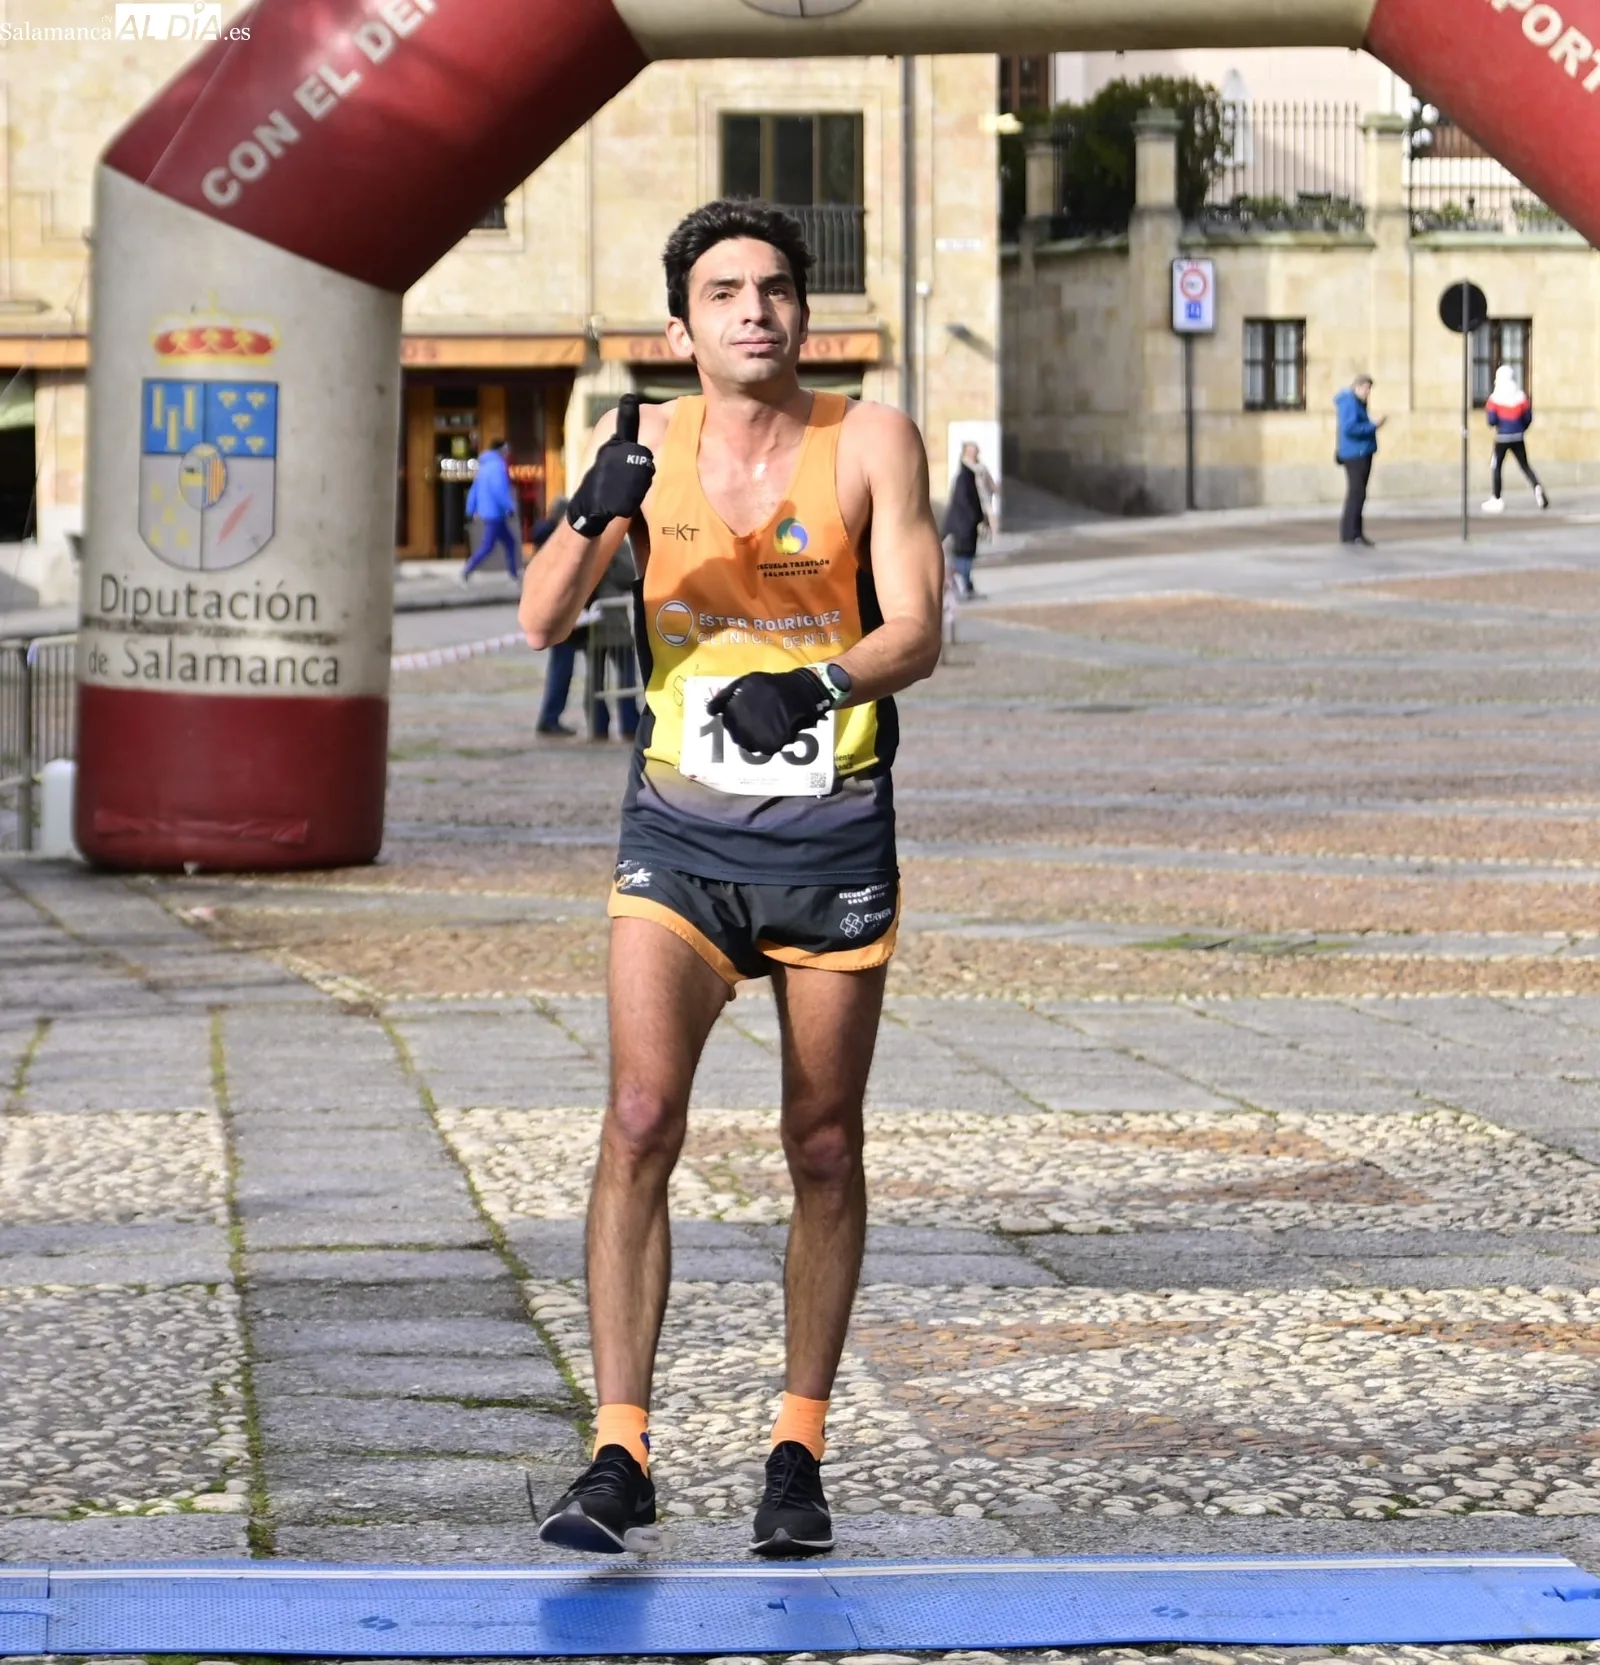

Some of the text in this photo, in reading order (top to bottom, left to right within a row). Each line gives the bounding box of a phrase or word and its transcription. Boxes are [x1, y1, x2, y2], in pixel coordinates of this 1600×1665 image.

[202, 109, 299, 207] CON
[293, 64, 361, 120] EL
[662, 523, 700, 541] EKT
[100, 572, 317, 624] Diputación
[699, 613, 748, 629] ESTER
[88, 637, 340, 686] de Salamanca
[700, 713, 819, 766] 15
